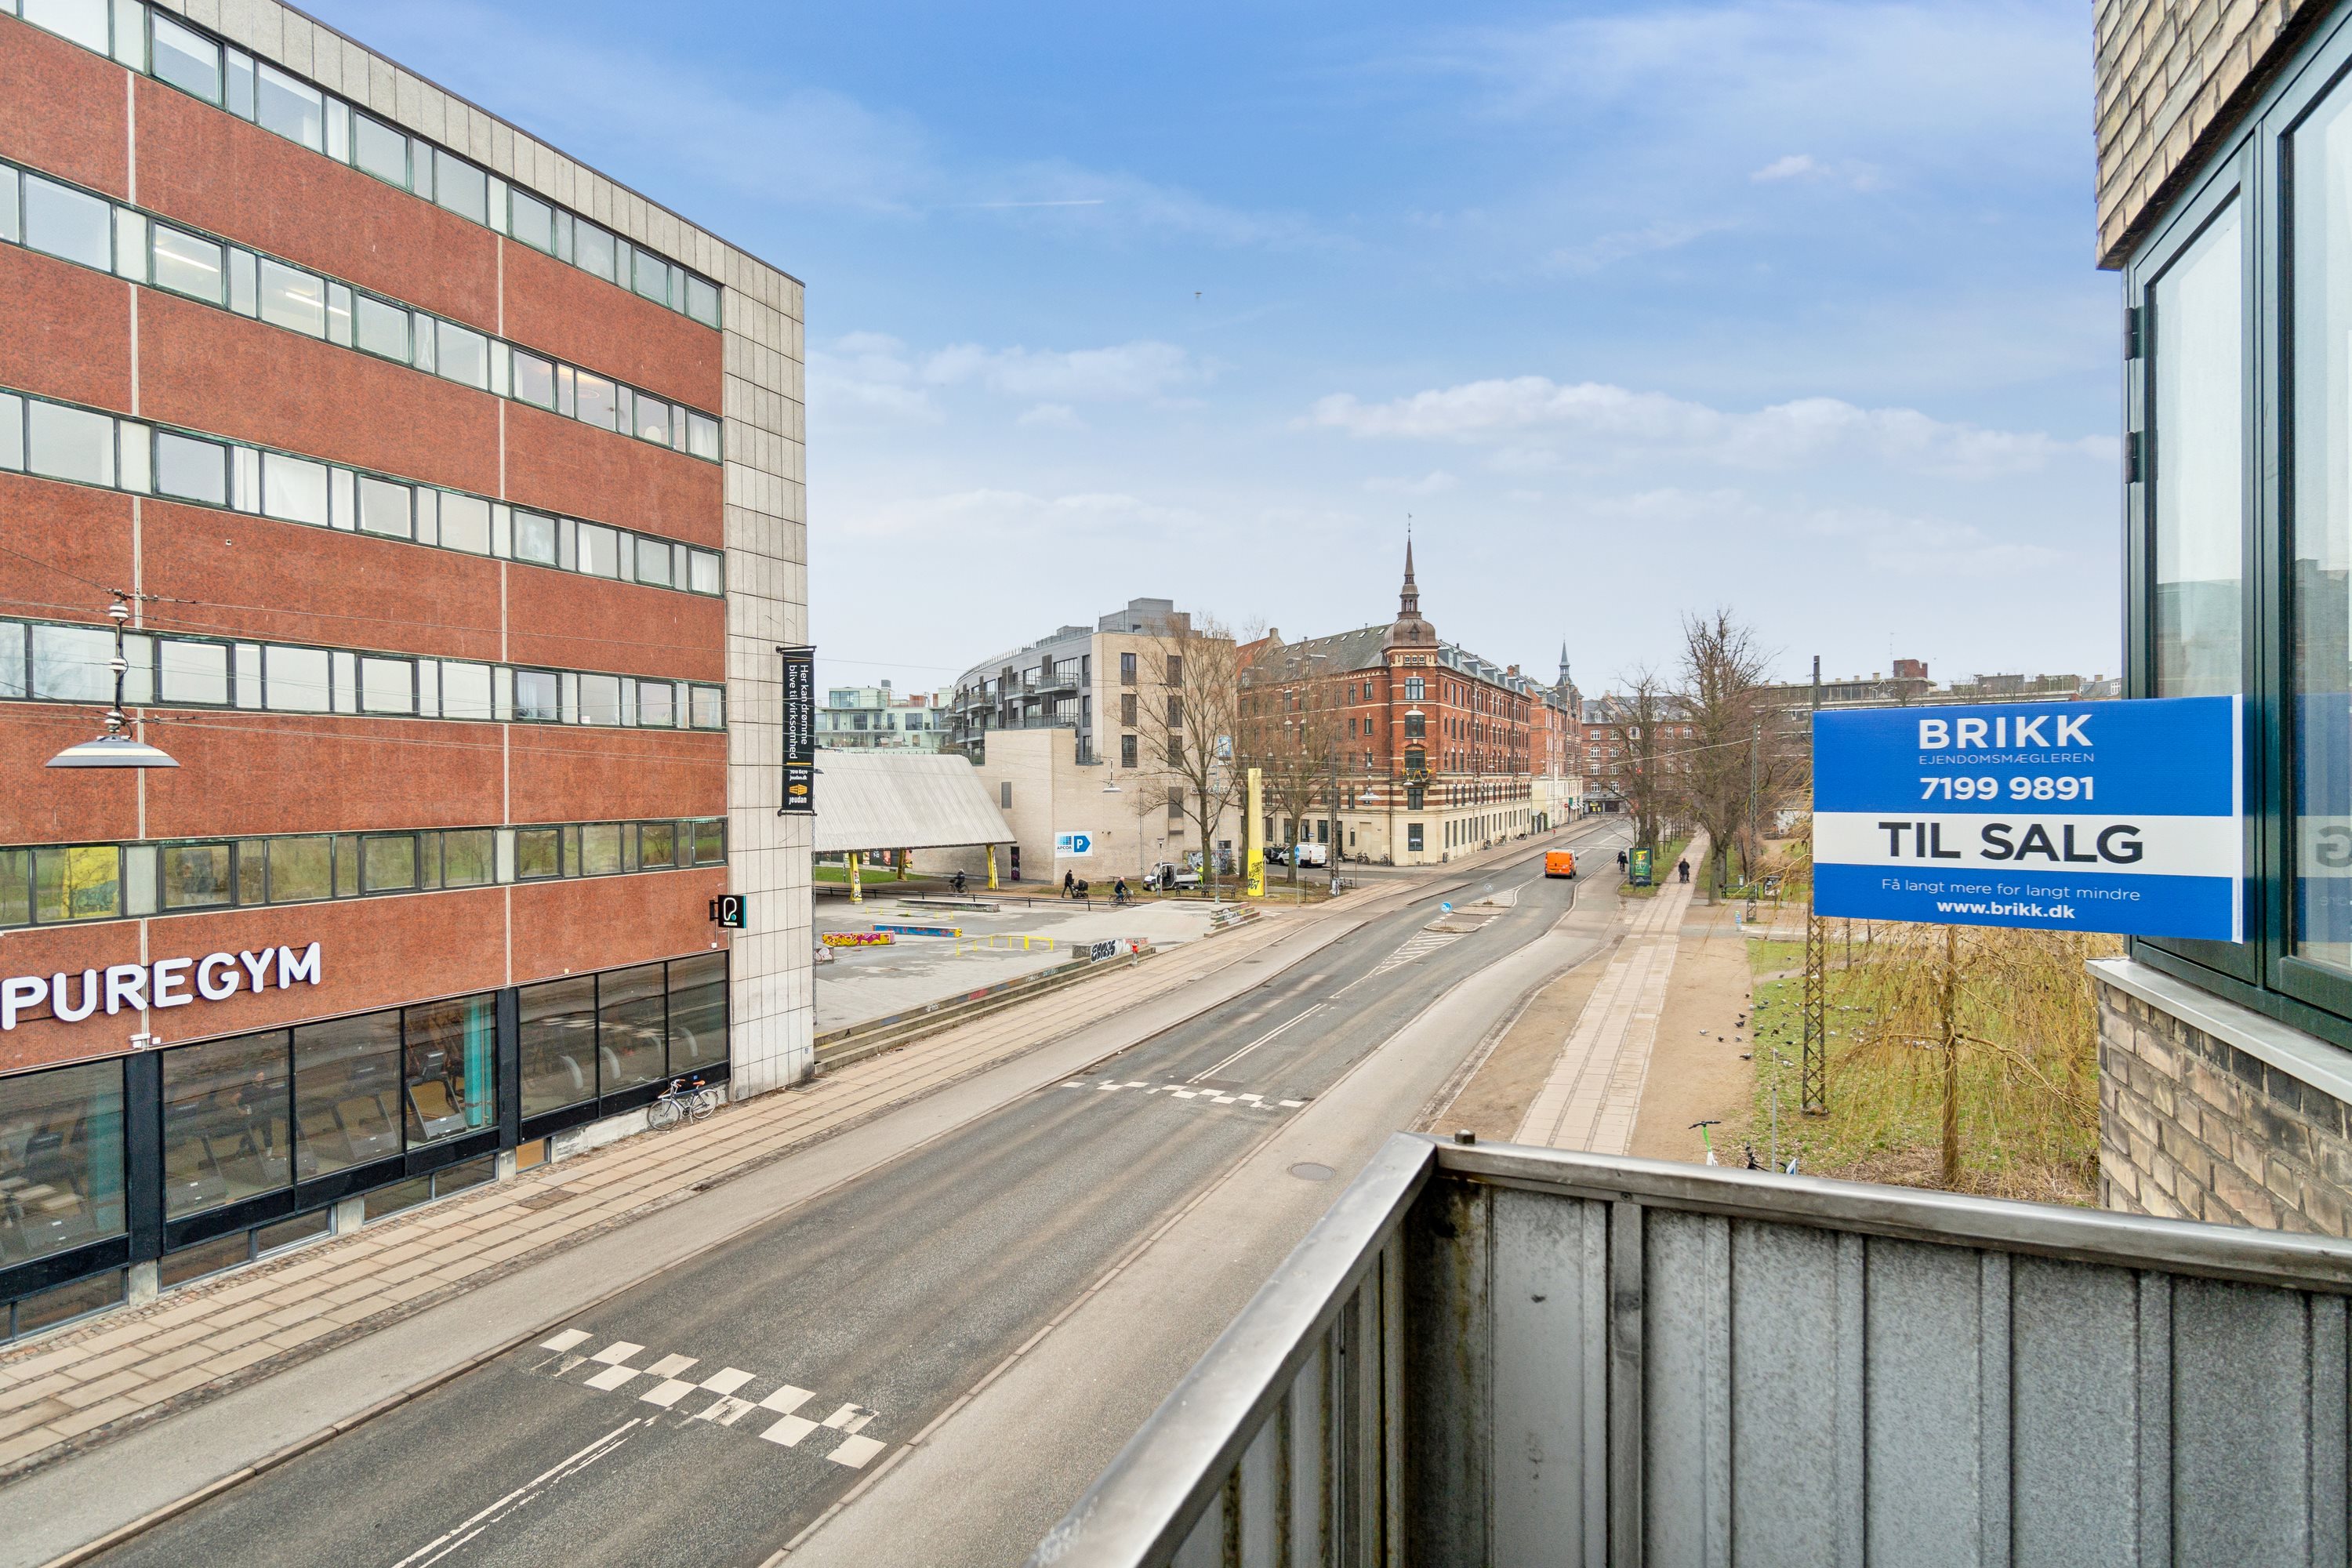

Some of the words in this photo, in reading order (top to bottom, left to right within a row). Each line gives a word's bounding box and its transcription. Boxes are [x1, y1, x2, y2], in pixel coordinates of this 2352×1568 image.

[789, 665, 797, 688] blive
[789, 702, 797, 759] virksomhed
[800, 704, 809, 745] drømme
[1919, 714, 2093, 750] BRIKK
[1918, 753, 2095, 764] EJENDOMSMÆGLEREN
[1920, 777, 1998, 800] 7199
[2009, 776, 2094, 800] 9891
[789, 796, 808, 805] jeudan
[1076, 839, 1083, 849] P
[1878, 822, 1961, 858] TIL
[1980, 822, 2143, 864] SALG
[1882, 878, 1900, 891] Få
[1905, 880, 1945, 894] langt
[1951, 884, 1992, 894] mere
[1997, 883, 2020, 895] for
[2027, 884, 2071, 899] langt
[2077, 887, 2140, 901] mindre
[1936, 901, 2076, 919] www.brikk.dk
[1, 942, 321, 1030] PUREGYM
